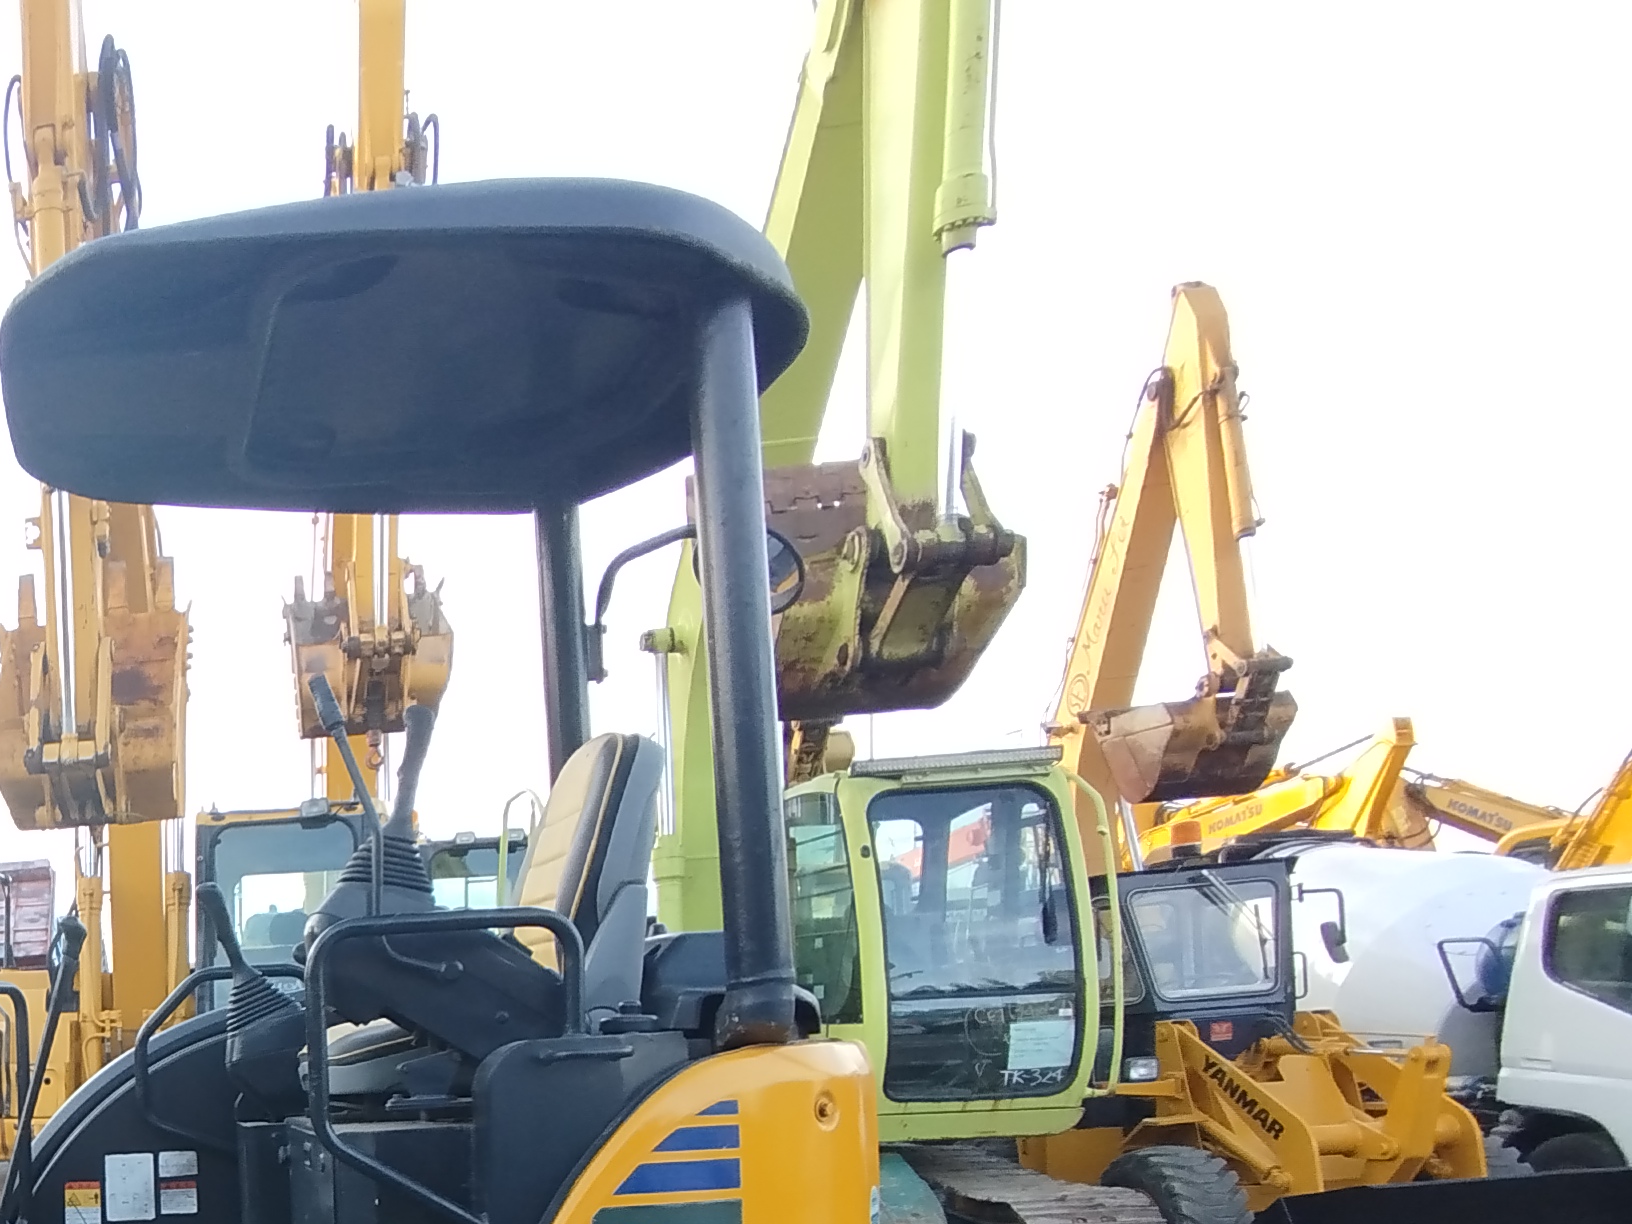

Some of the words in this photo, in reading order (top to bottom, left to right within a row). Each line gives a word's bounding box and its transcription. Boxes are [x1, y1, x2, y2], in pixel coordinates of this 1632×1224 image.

[1208, 803, 1263, 835] KOMATSU
[1448, 798, 1513, 831] KOMATSU
[1203, 1054, 1285, 1140] YANMAR
